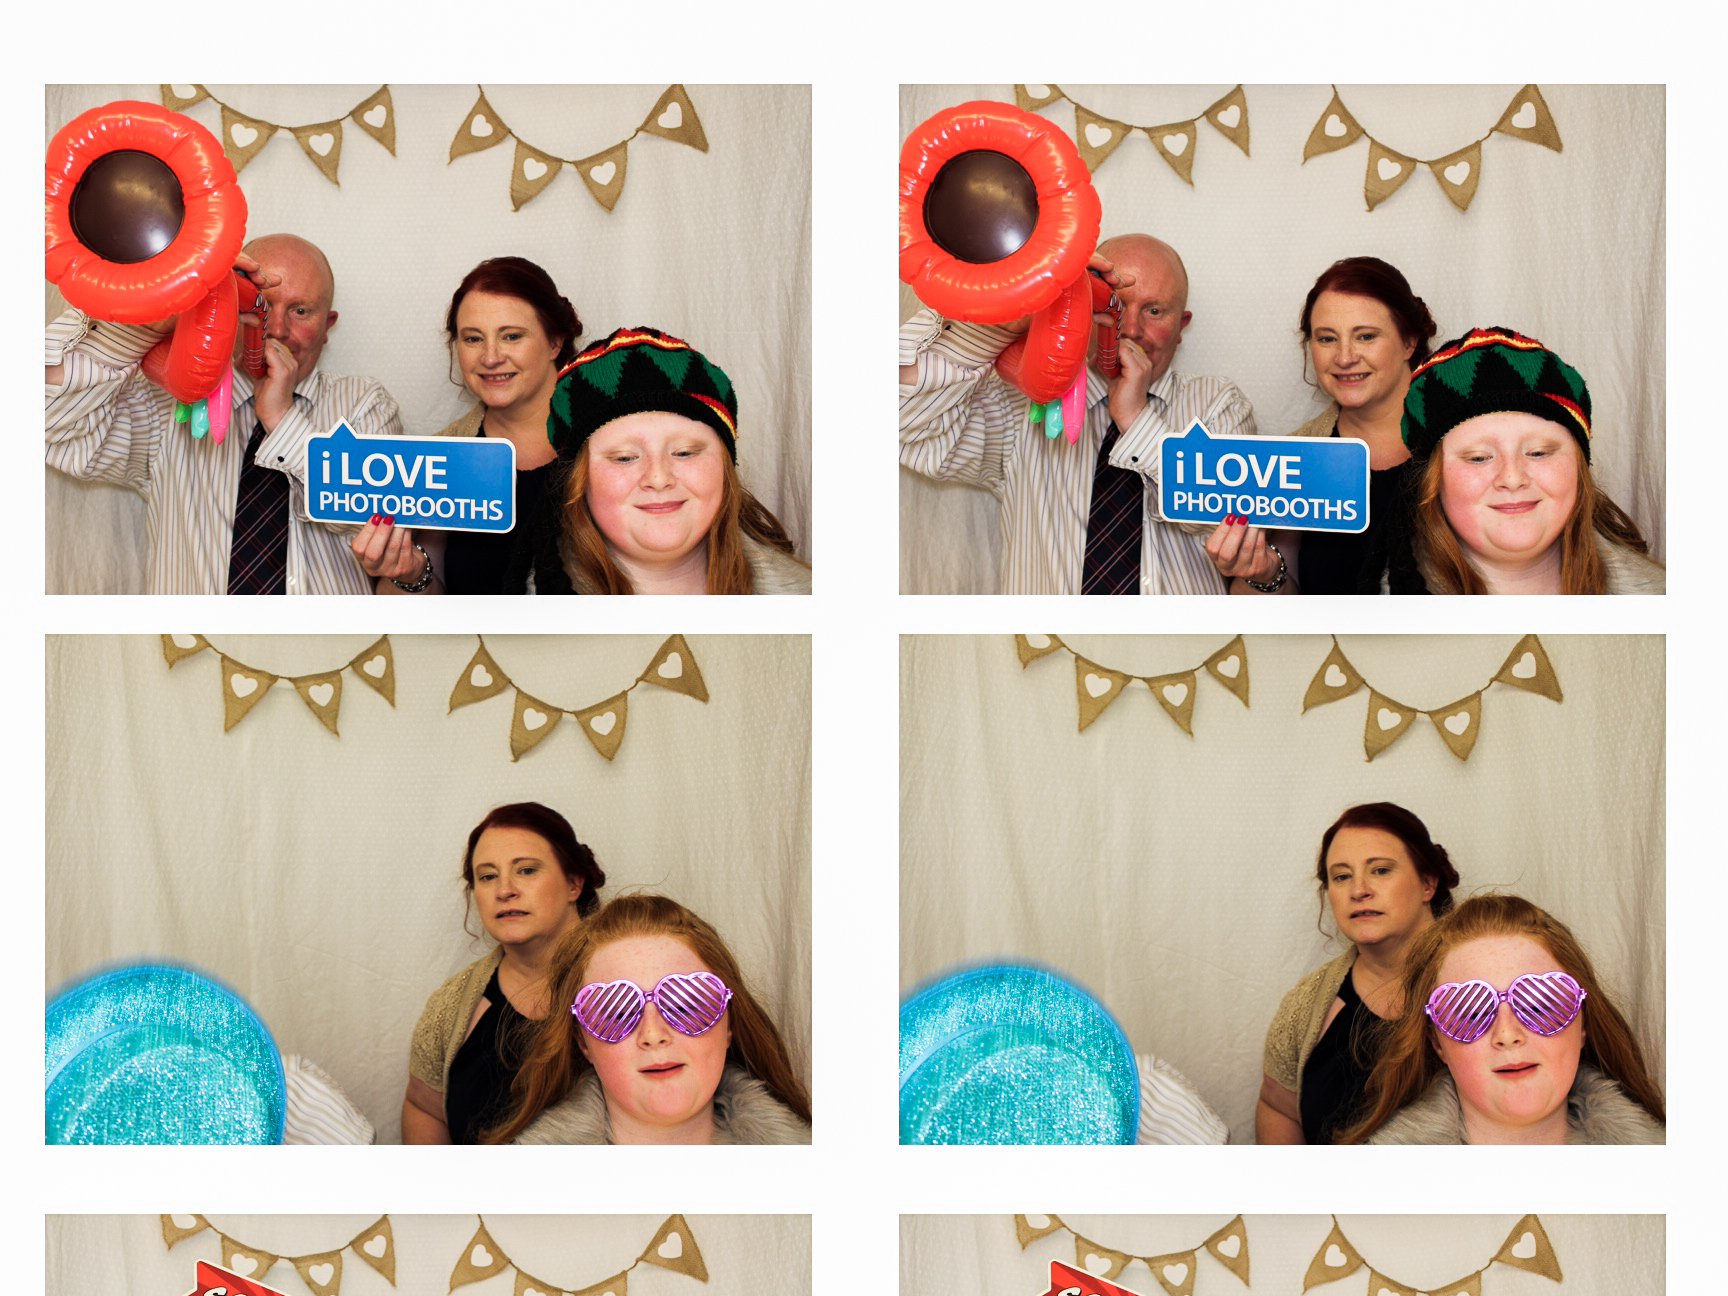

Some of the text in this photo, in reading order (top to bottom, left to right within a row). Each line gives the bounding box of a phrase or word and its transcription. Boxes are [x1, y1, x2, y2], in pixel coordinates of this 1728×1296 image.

[321, 450, 448, 490] i LOVE
[1175, 450, 1302, 490] i LOVE
[319, 491, 504, 521] PHOTOBOOTHS
[1173, 491, 1358, 521] PHOTOBOOTHS
